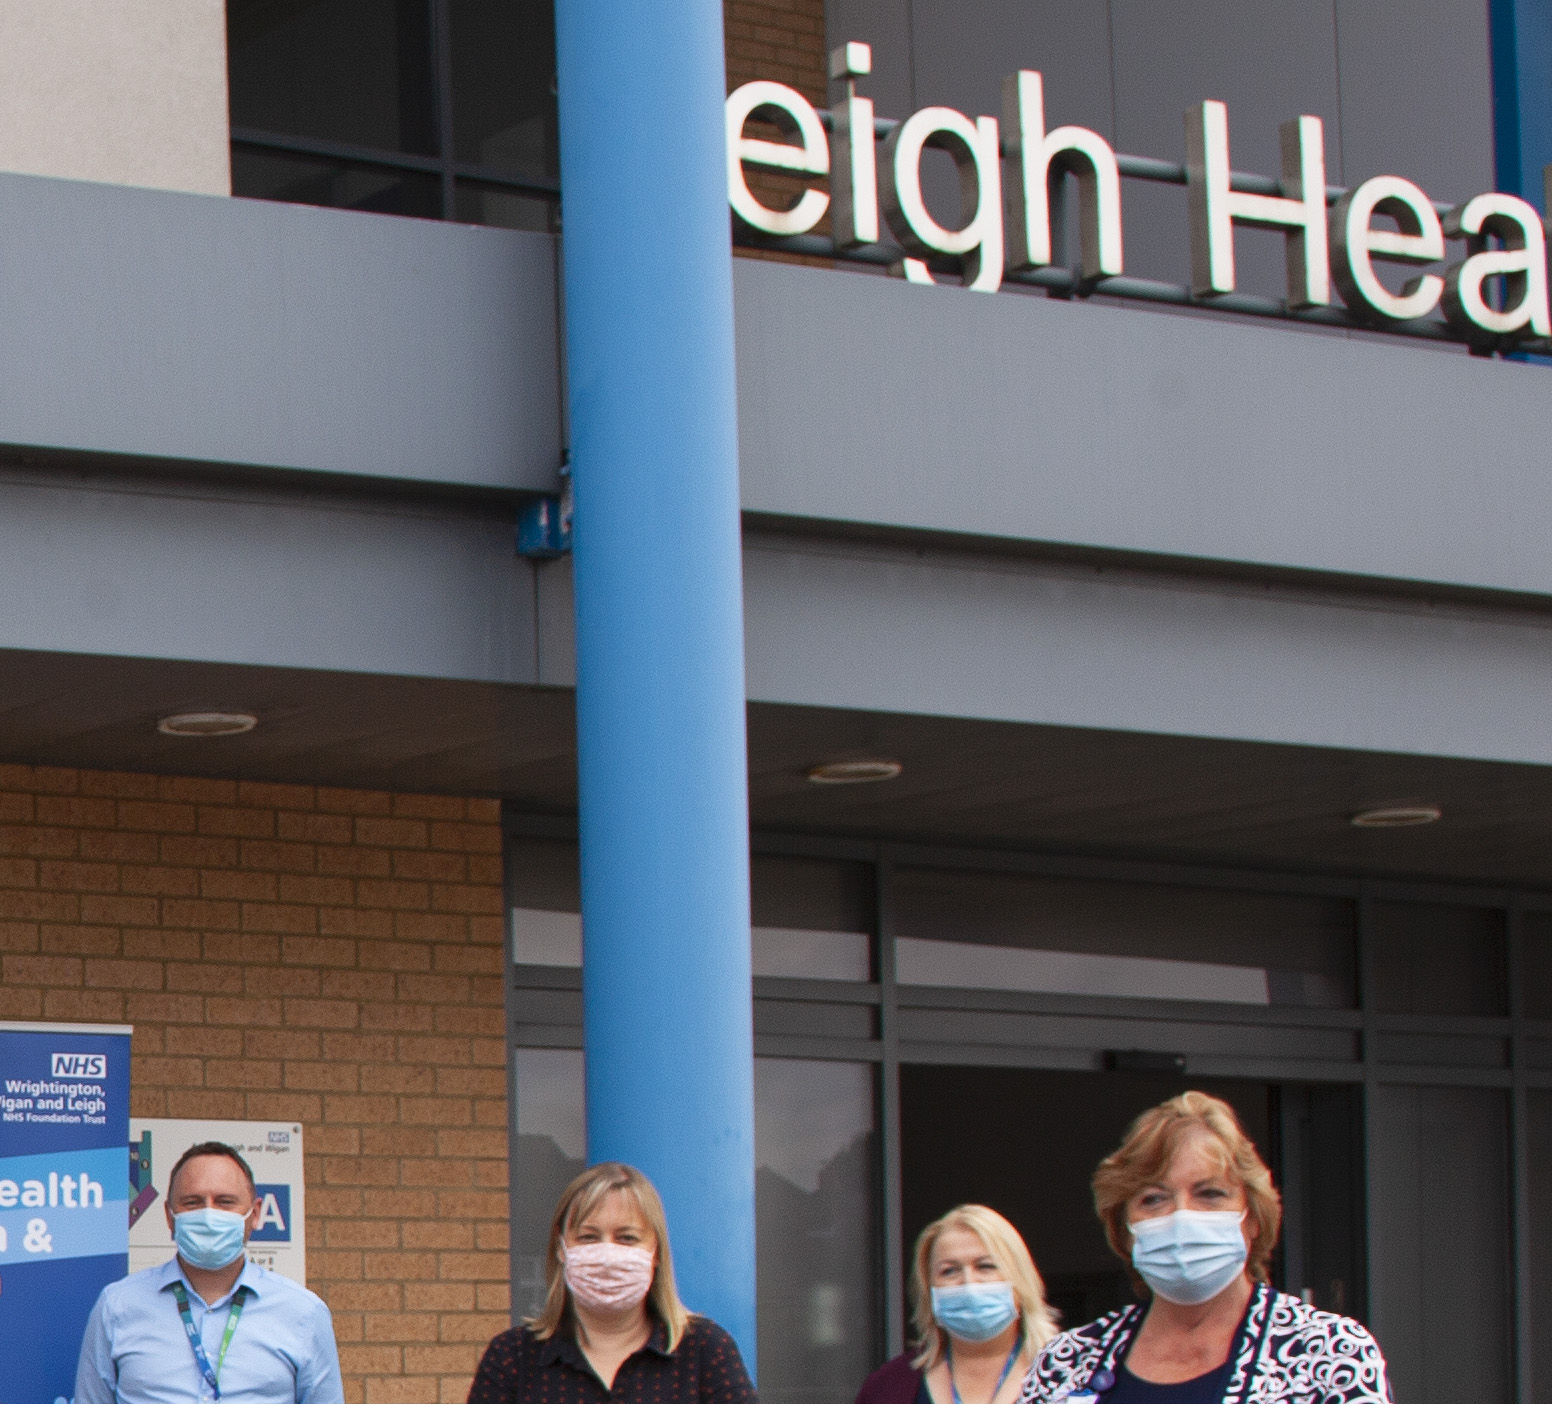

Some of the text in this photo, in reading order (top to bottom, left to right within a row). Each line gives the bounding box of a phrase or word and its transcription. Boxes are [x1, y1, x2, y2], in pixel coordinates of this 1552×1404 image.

[724, 41, 1552, 336] eigh Hea
[55, 1056, 103, 1075] NHS
[6, 1080, 105, 1097] Wrightington,
[37, 1097, 63, 1110] and
[67, 1097, 105, 1114] Leigh
[3, 1112, 106, 1124] NHS Foundation Trust
[257, 1193, 286, 1230] A
[23, 1218, 53, 1253] &
